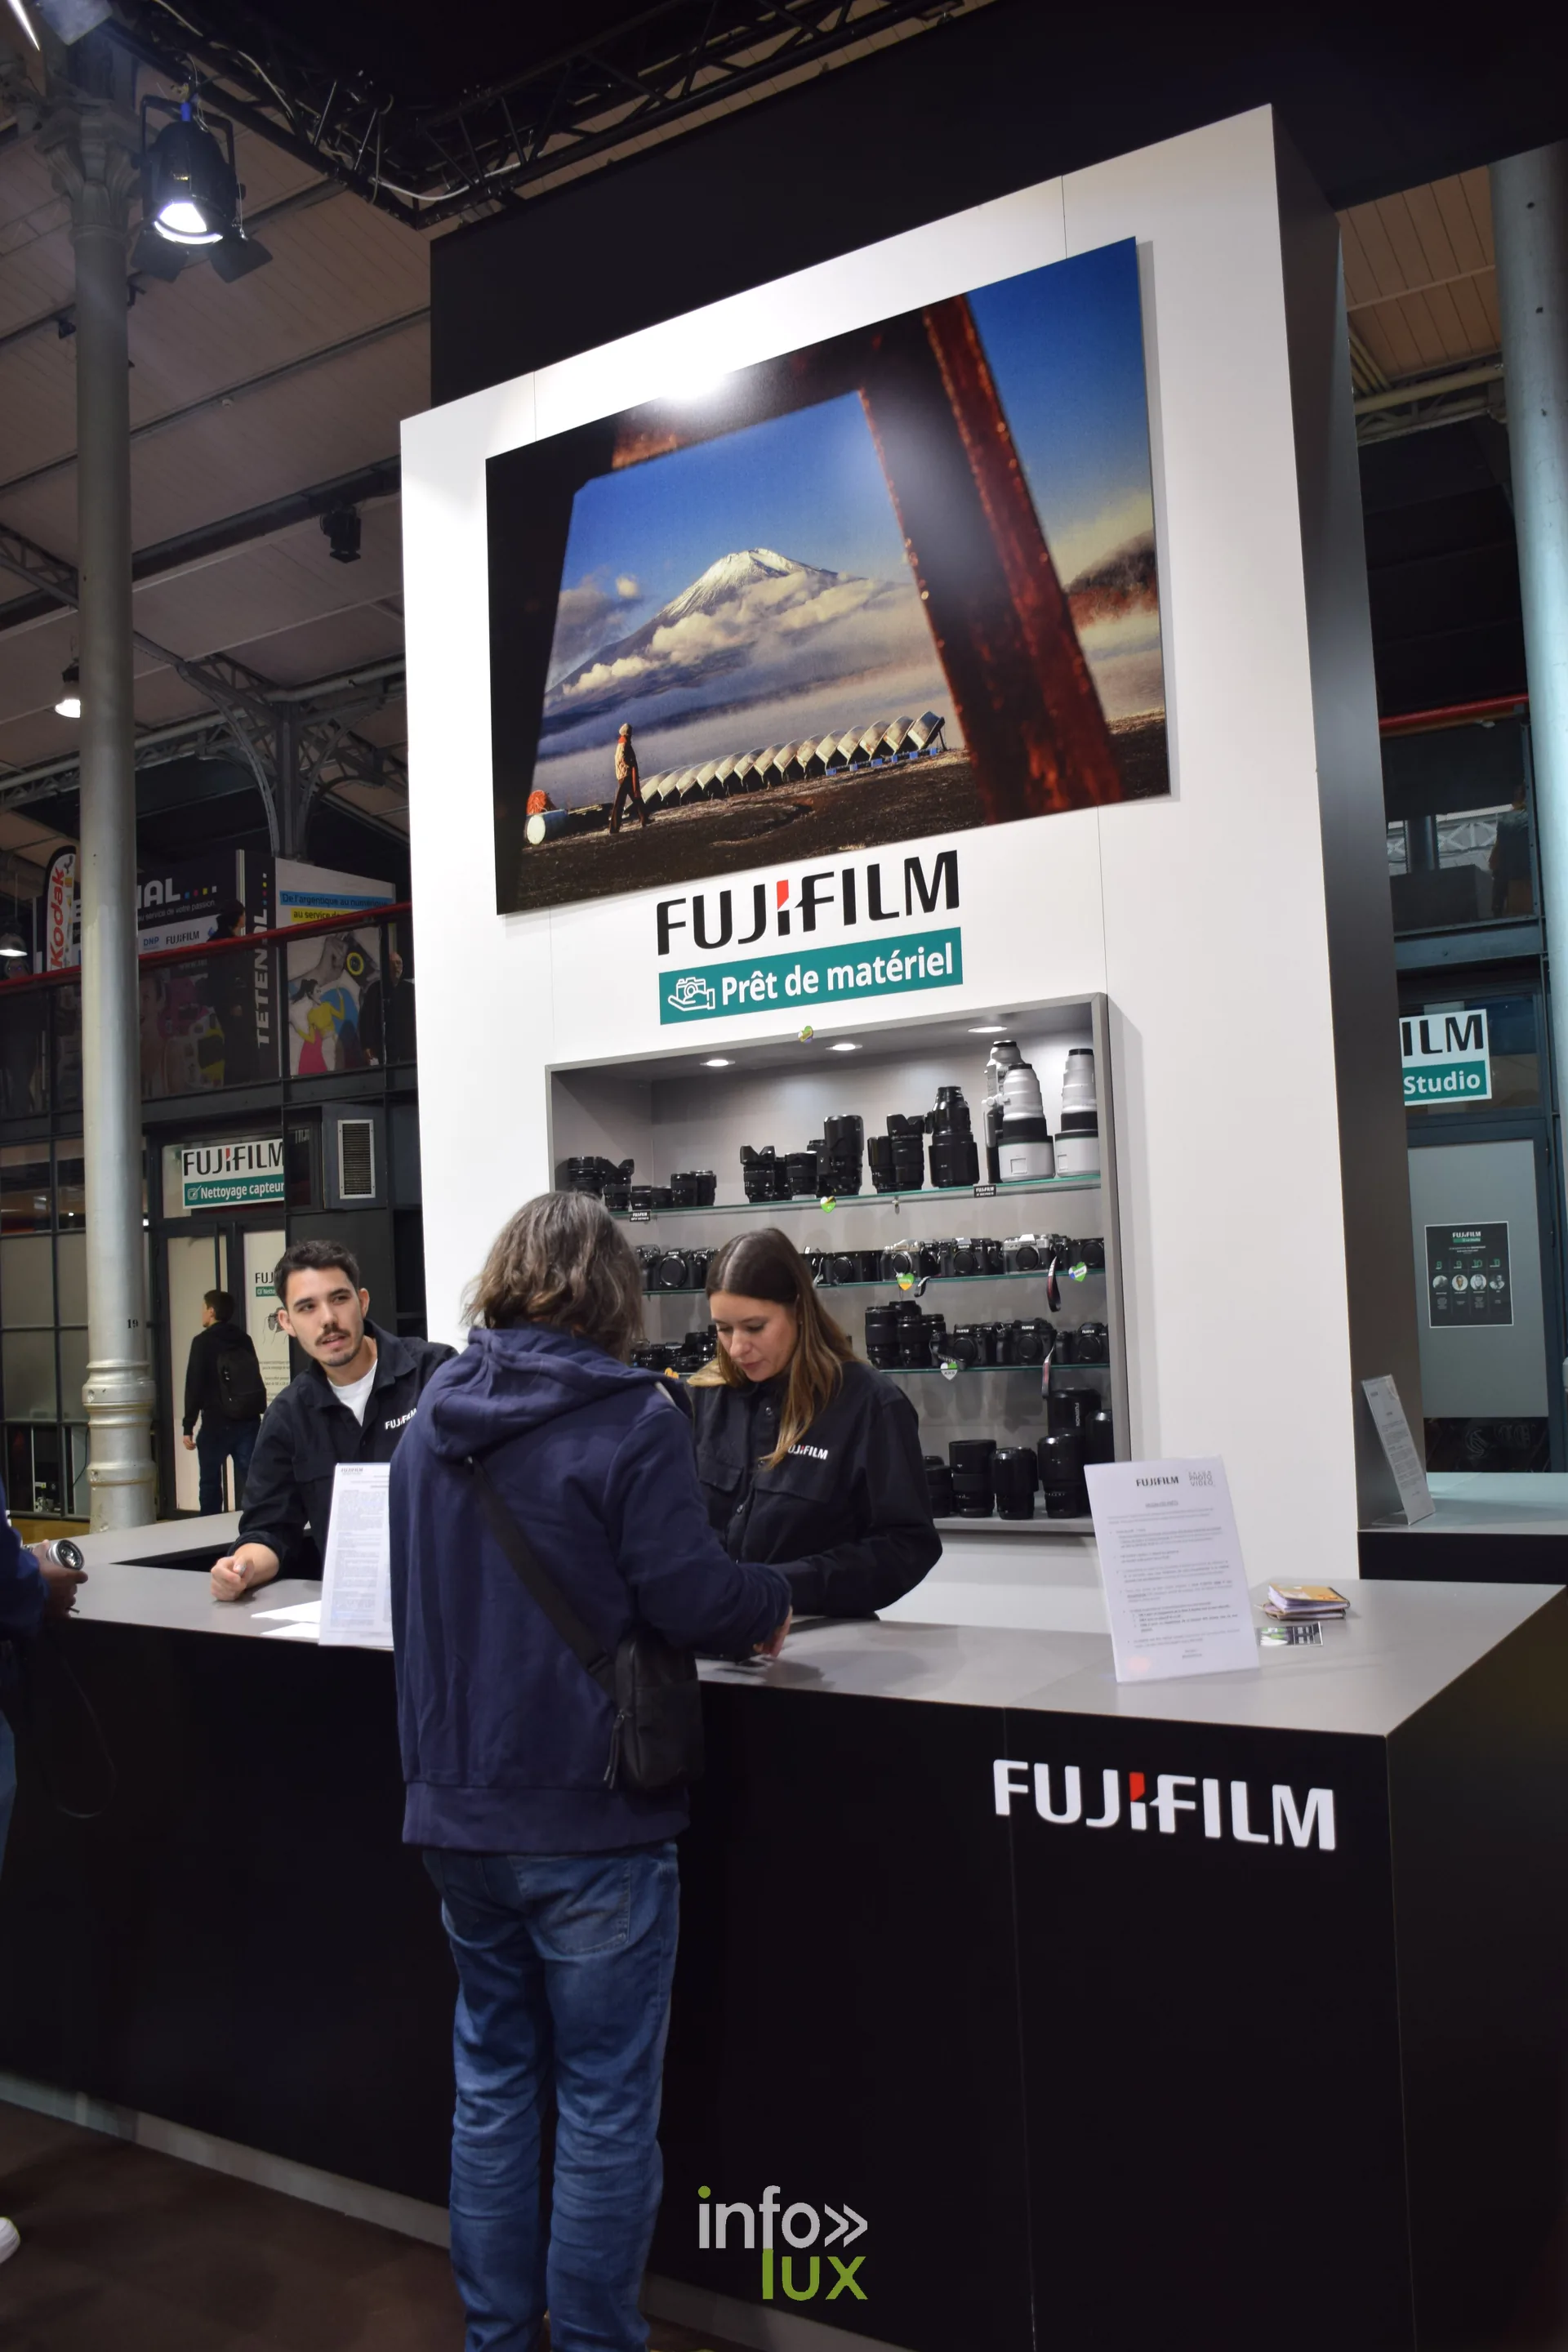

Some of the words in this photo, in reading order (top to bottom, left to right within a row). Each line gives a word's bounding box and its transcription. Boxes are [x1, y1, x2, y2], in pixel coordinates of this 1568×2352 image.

[283, 894, 293, 902] De
[657, 850, 960, 956] FUJIFILM
[51, 866, 65, 968] Kodak
[176, 904, 191, 914] votre
[143, 936, 160, 946] DNP
[166, 930, 200, 944] FUJIFILM
[722, 970, 778, 1005] Prêt
[785, 964, 819, 996] de
[827, 942, 954, 990] matériel
[1404, 1071, 1481, 1095] Studio
[184, 1143, 284, 1176] FUJIFILM
[201, 1185, 247, 1200] Nettoyage
[249, 1183, 284, 1197] capteur
[787, 1444, 829, 1460] UJIFILM
[1136, 1476, 1179, 1486] FUJIFILM
[993, 1758, 1336, 1851] FUJIFILM
